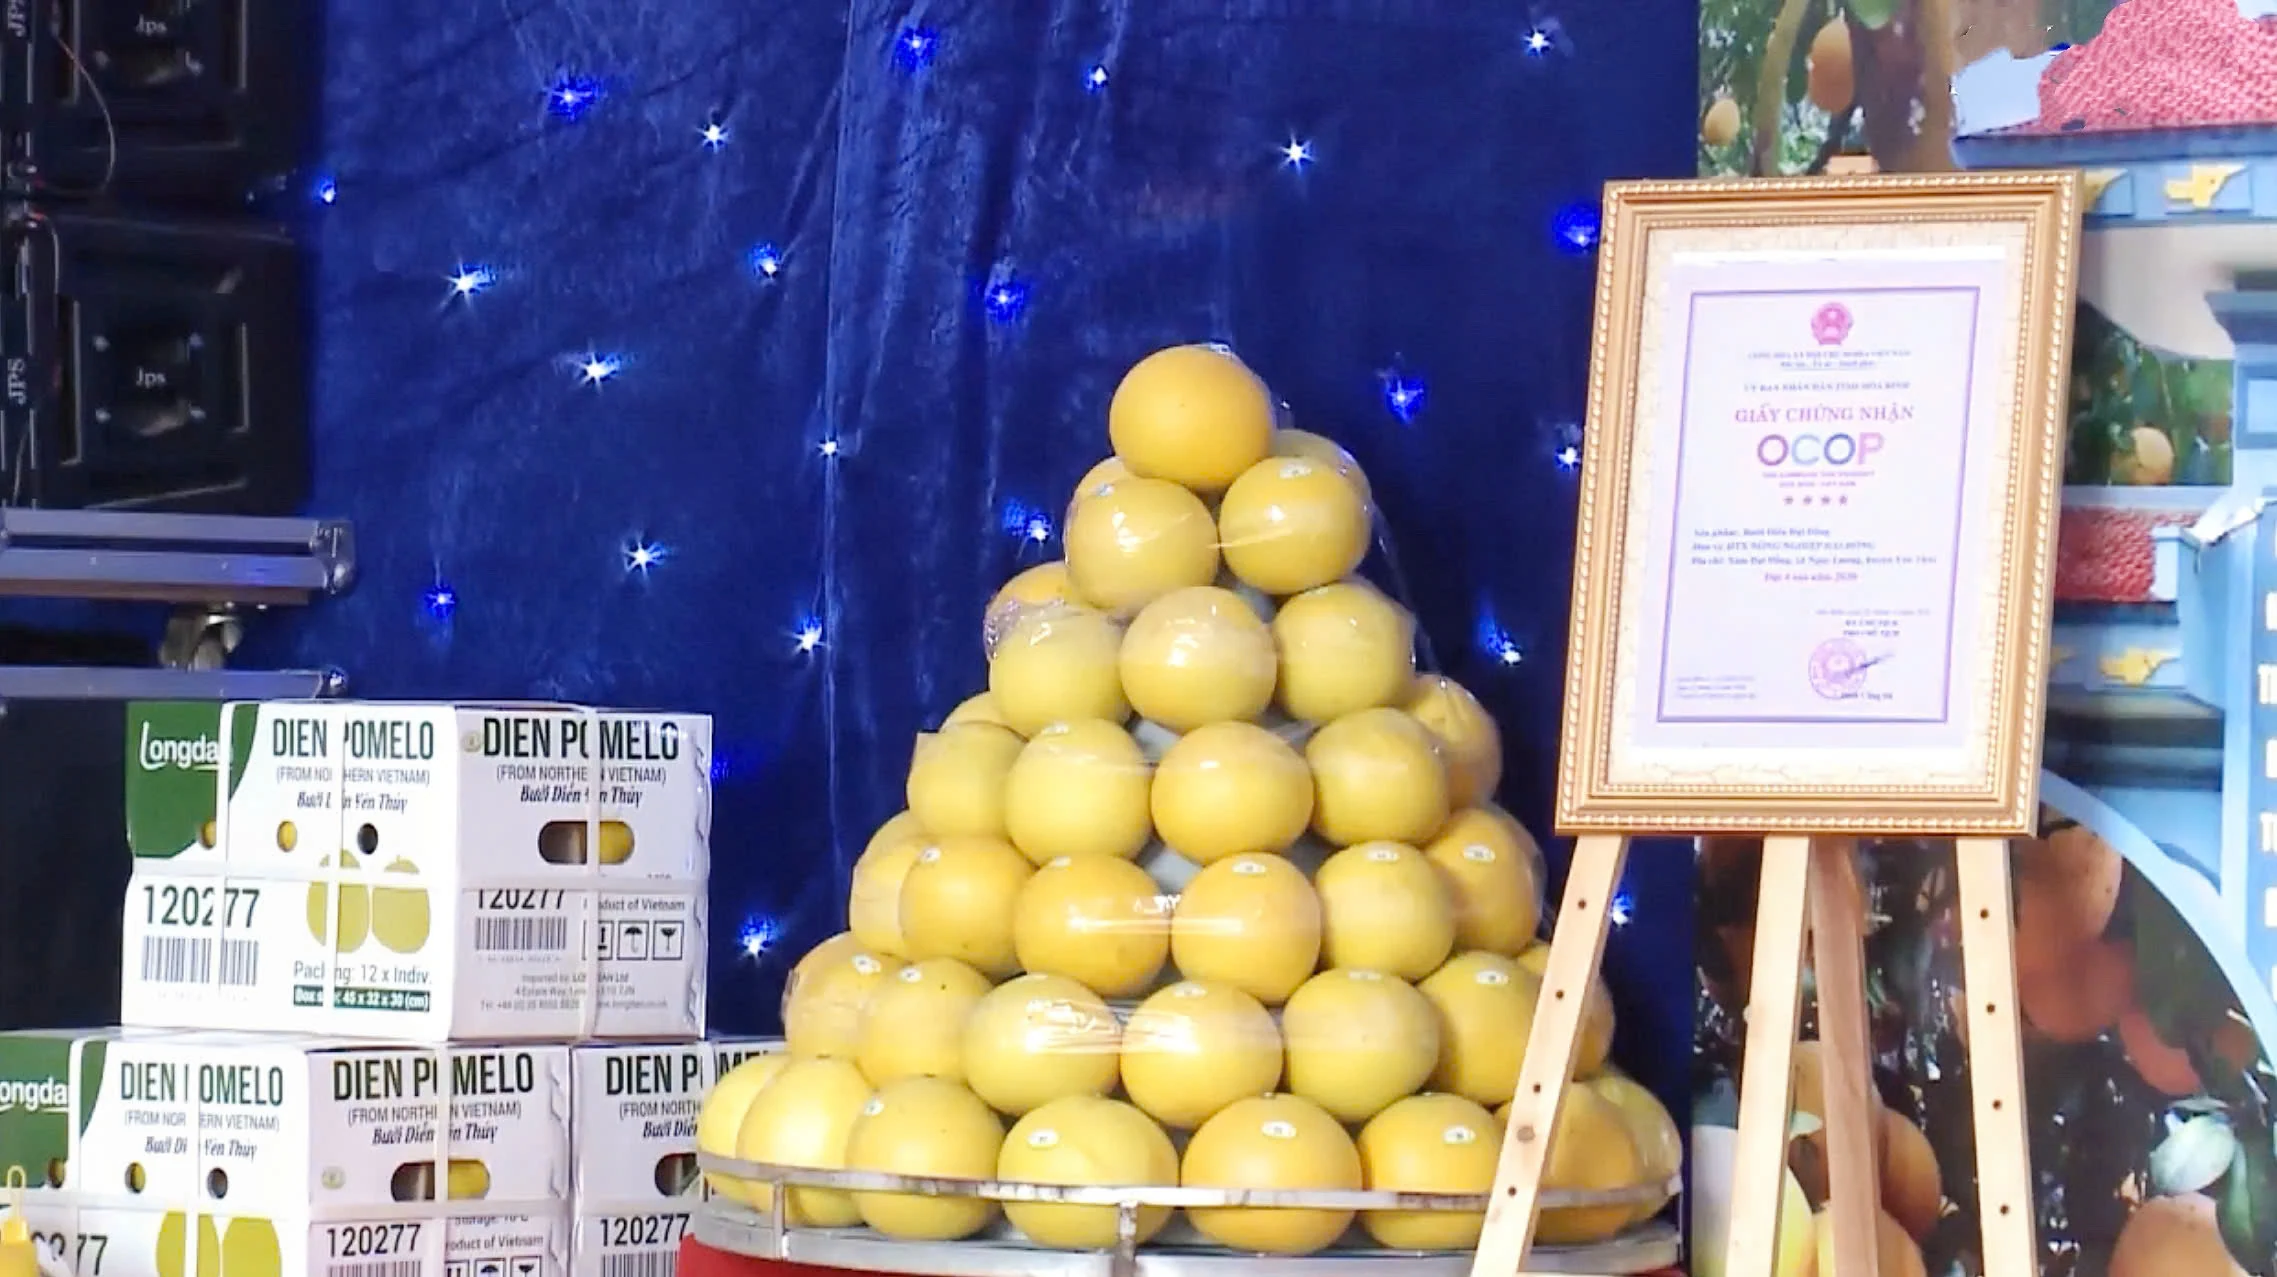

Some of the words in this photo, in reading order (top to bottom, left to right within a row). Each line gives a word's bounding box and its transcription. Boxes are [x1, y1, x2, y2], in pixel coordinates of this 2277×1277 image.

[7, 357, 27, 404] JPS
[1735, 402, 1781, 424] GIẤY
[1786, 402, 1854, 422] CHỨNG
[1860, 402, 1915, 424] NHẬN
[1757, 432, 1885, 466] OCOP
[139, 721, 219, 771] Longda
[272, 718, 327, 757] DIEN
[344, 719, 434, 760] OMELO
[484, 718, 550, 758] DIEN
[276, 765, 315, 784] (FROM
[319, 765, 374, 784] NOHERN
[378, 767, 430, 785] VIETNAM)
[497, 765, 536, 783] (FROM
[539, 766, 605, 781] NORTHE
[608, 766, 667, 785] VIETNAM)
[143, 885, 260, 928] 120277
[478, 889, 565, 910] 120277
[627, 899, 640, 911] of
[642, 898, 685, 911] Vietnam
[294, 960, 354, 984] Pacng:
[361, 964, 377, 982] 12
[381, 970, 391, 982] x
[394, 965, 432, 984] Indiv.
[121, 1062, 175, 1102] DIEN
[333, 1059, 402, 1101] DIEN
[414, 1053, 534, 1097] PMELO
[606, 1055, 672, 1095] DIEN
[0, 1077, 69, 1113] ongda
[620, 1101, 658, 1120] (FROM
[661, 1099, 701, 1116] NORTH
[125, 1110, 159, 1127] (FROM
[162, 1111, 223, 1129] NORERN
[226, 1114, 280, 1132] VIETNAM)
[349, 1106, 389, 1127] (FROM
[392, 1104, 459, 1122] NORTHN
[462, 1100, 522, 1119] VIETNAM)
[327, 1224, 421, 1258] 120277
[445, 1238, 481, 1251] roduct
[484, 1236, 497, 1249] of
[498, 1235, 544, 1248] Vietnam
[600, 1213, 690, 1246] 120277
